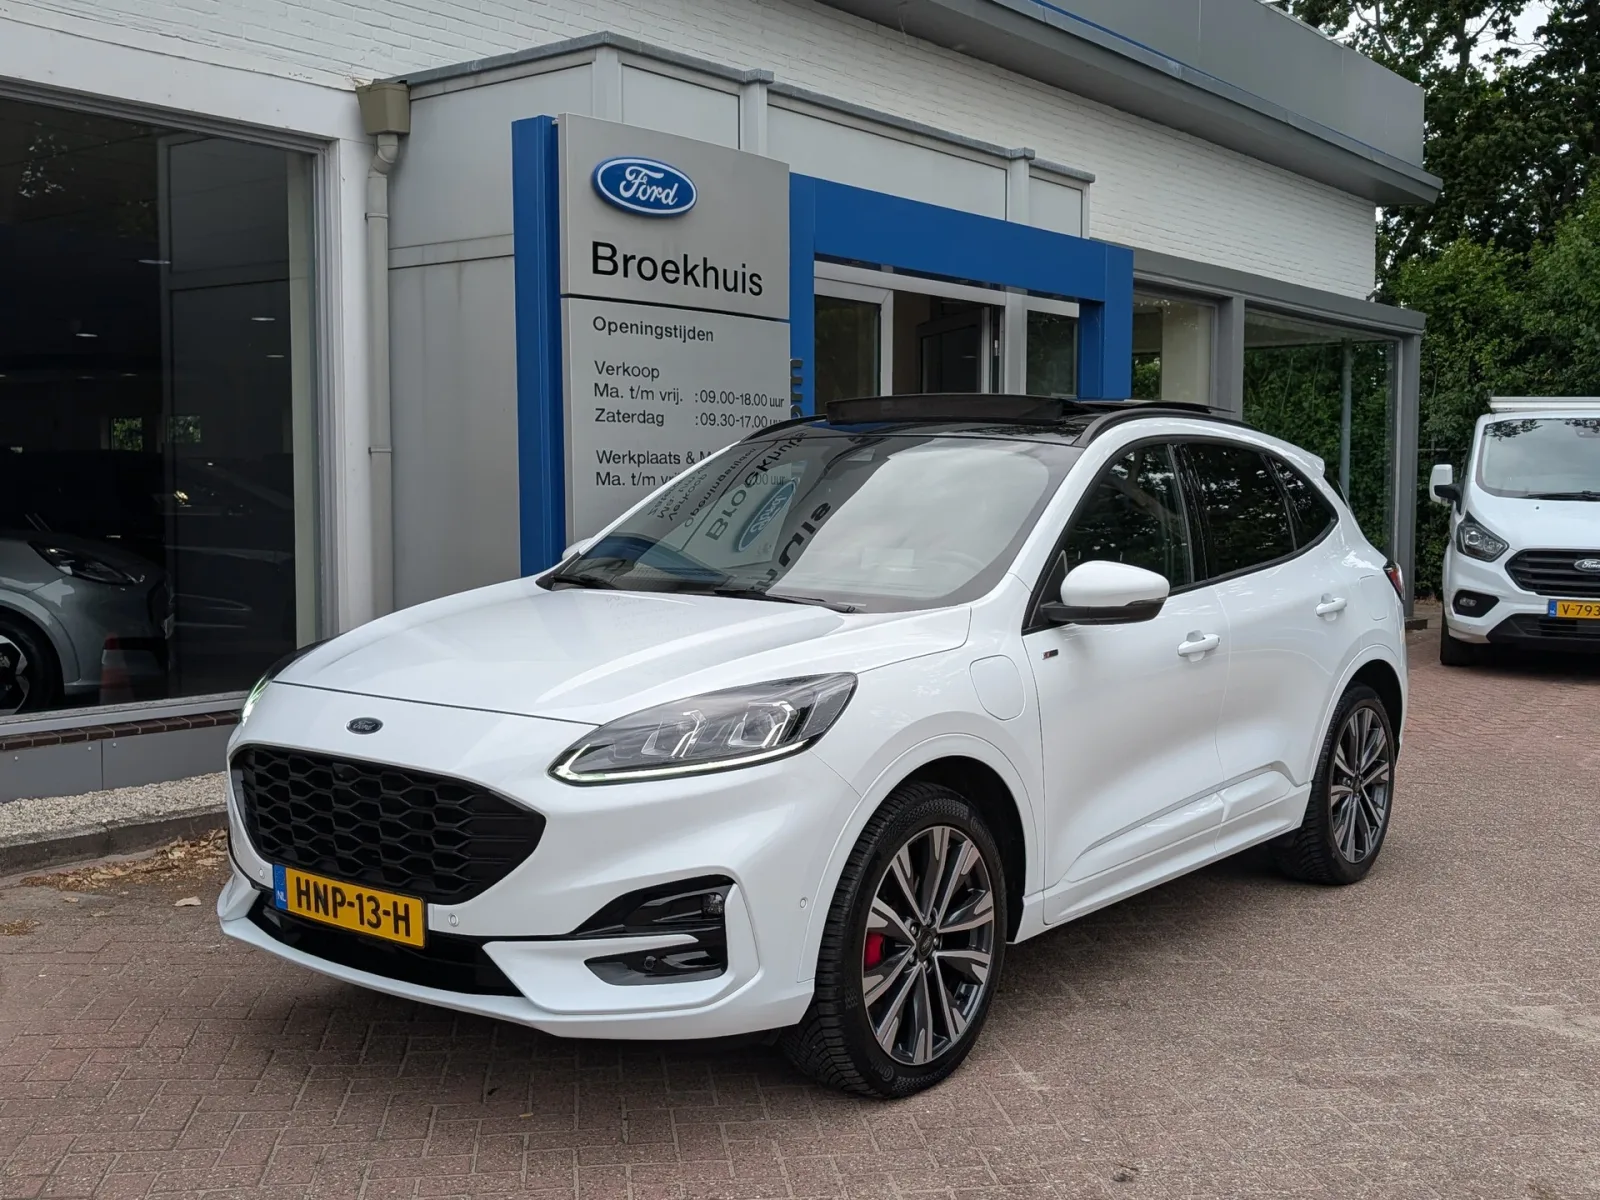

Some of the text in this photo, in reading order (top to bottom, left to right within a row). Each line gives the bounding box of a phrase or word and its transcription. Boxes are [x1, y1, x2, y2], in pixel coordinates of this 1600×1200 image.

[619, 165, 679, 206] Ford
[592, 240, 763, 297] Broekhuis
[592, 315, 714, 343] Openingstijden
[593, 360, 660, 382] Verkoop
[594, 382, 624, 399] Ma.
[629, 385, 655, 401] t/m
[659, 388, 683, 405] vrij.
[769, 397, 785, 408] uur
[594, 407, 665, 427] Zaterdag
[596, 450, 681, 467] Werkplaats
[686, 451, 696, 465] &
[596, 471, 626, 486] Ma.
[631, 472, 656, 486] t/m
[276, 889, 287, 902] NL
[295, 876, 411, 938] HNP-13-H
